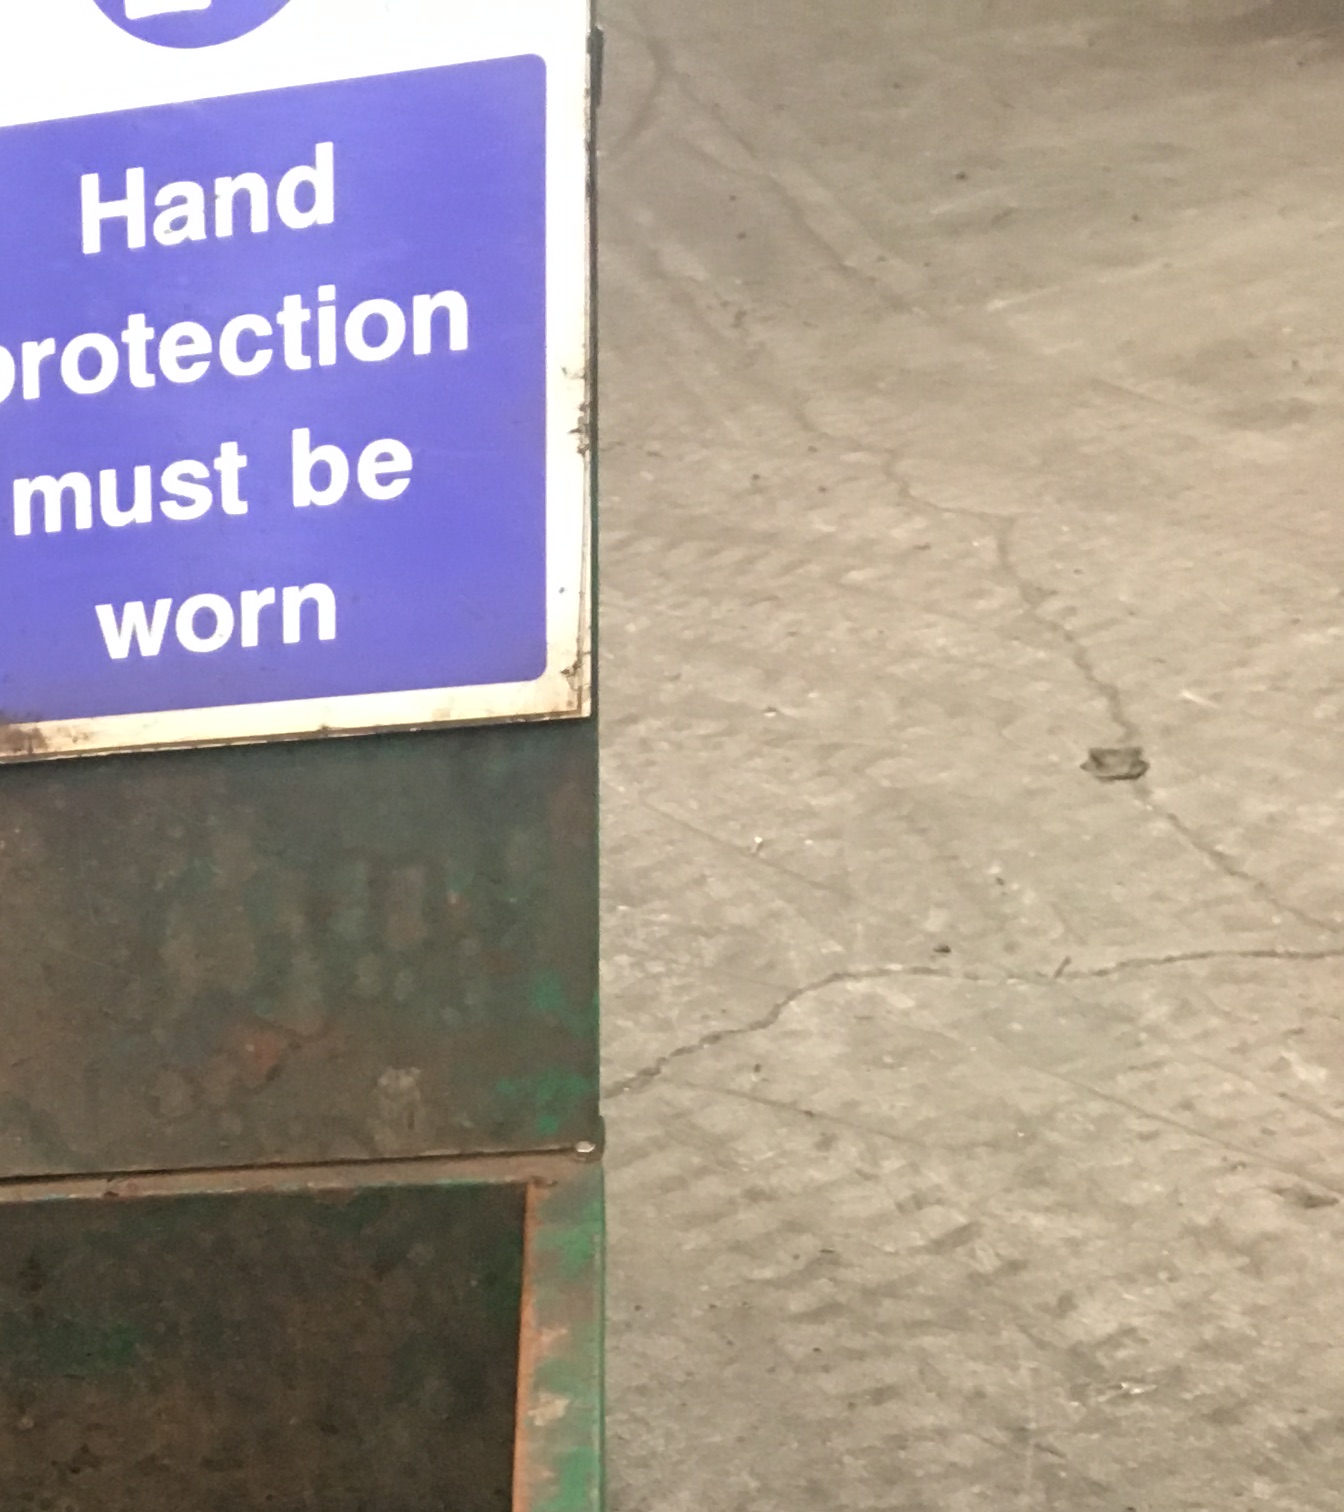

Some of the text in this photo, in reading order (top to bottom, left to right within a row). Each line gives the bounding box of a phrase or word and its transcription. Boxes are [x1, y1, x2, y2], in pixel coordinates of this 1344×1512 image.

[79, 141, 336, 256] Hand
[12, 426, 413, 537] must be
[95, 580, 337, 660] worn
